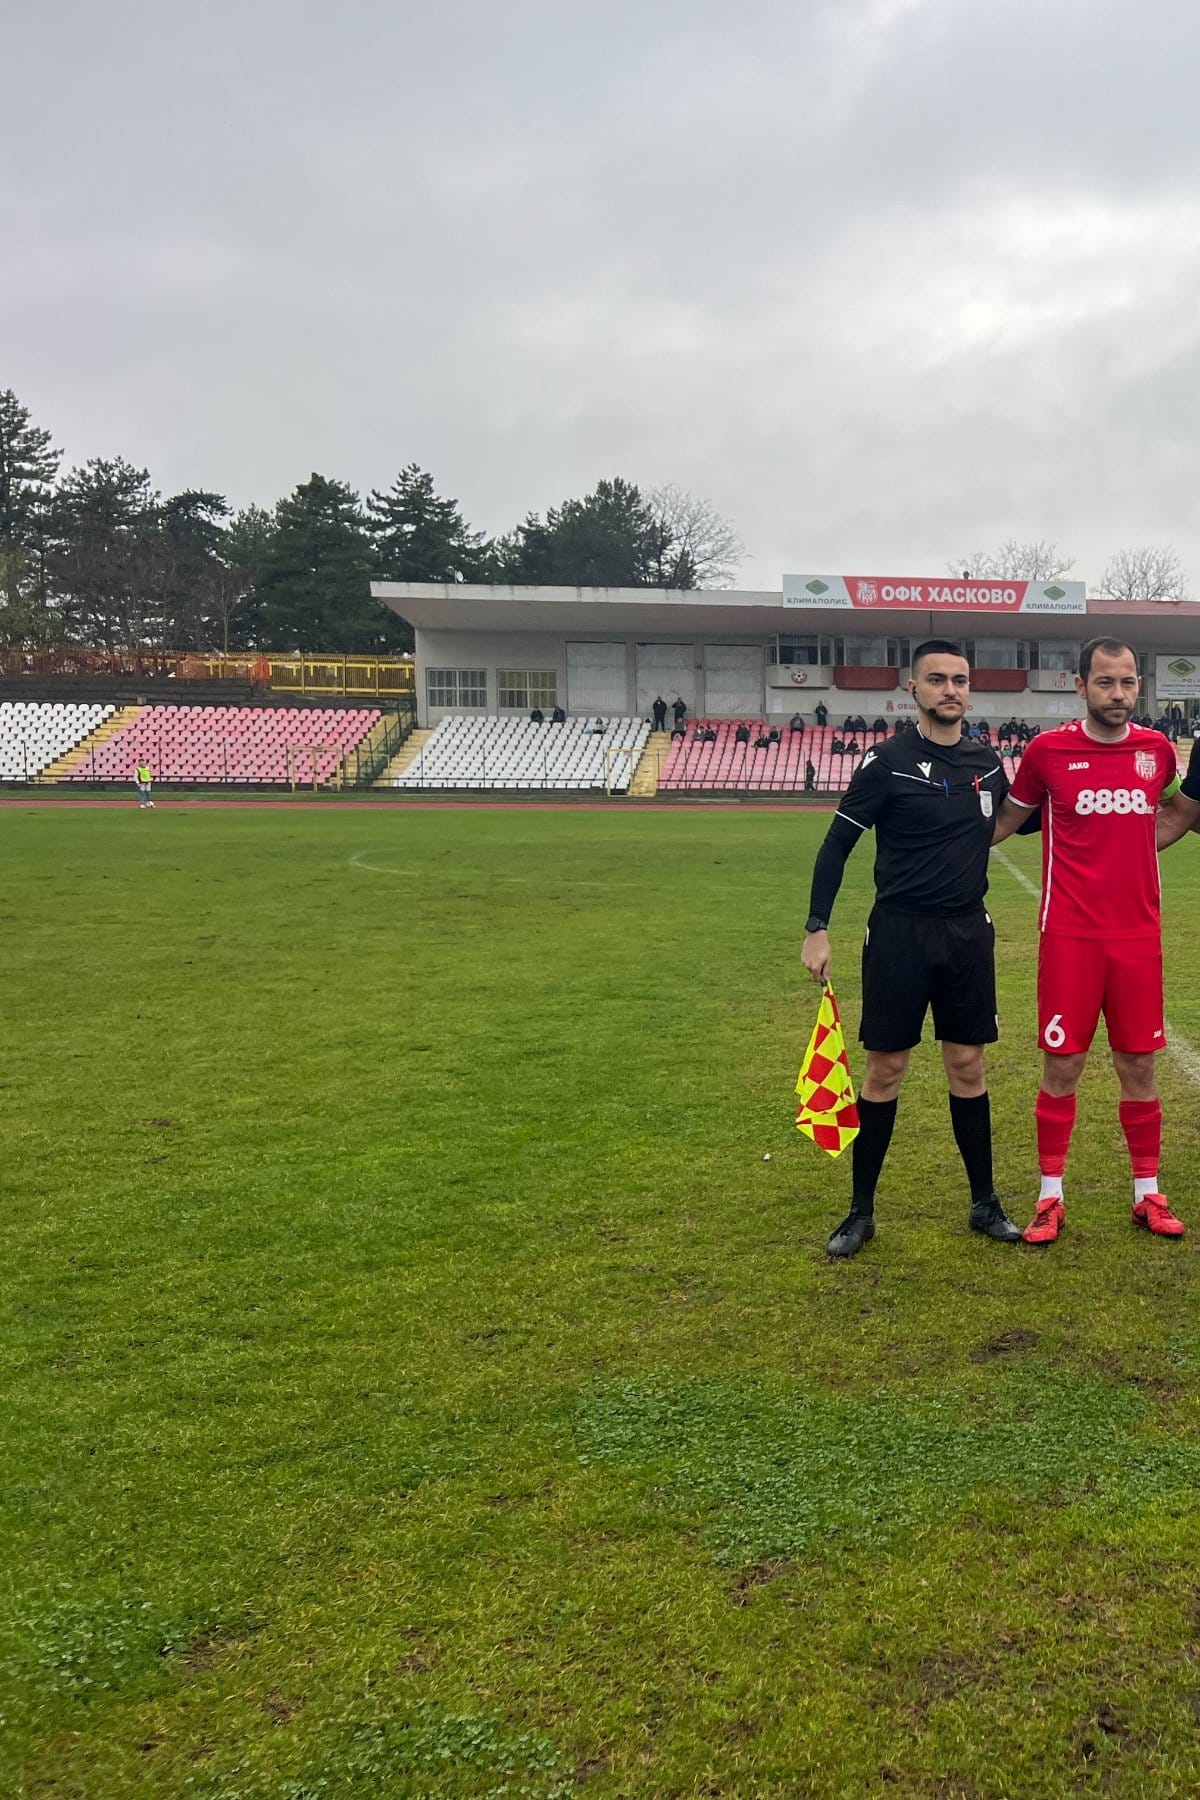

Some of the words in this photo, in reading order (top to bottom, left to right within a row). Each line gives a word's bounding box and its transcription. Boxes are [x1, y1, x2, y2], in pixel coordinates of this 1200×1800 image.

[881, 585, 922, 602] ОФК
[927, 586, 1017, 605] ХАСКОВО
[787, 597, 848, 605] КЛИМАПОЛИС
[1026, 603, 1083, 611] КЛИМАПОЛИС
[1067, 761, 1090, 771] JAKO
[1044, 1014, 1066, 1048] 6
